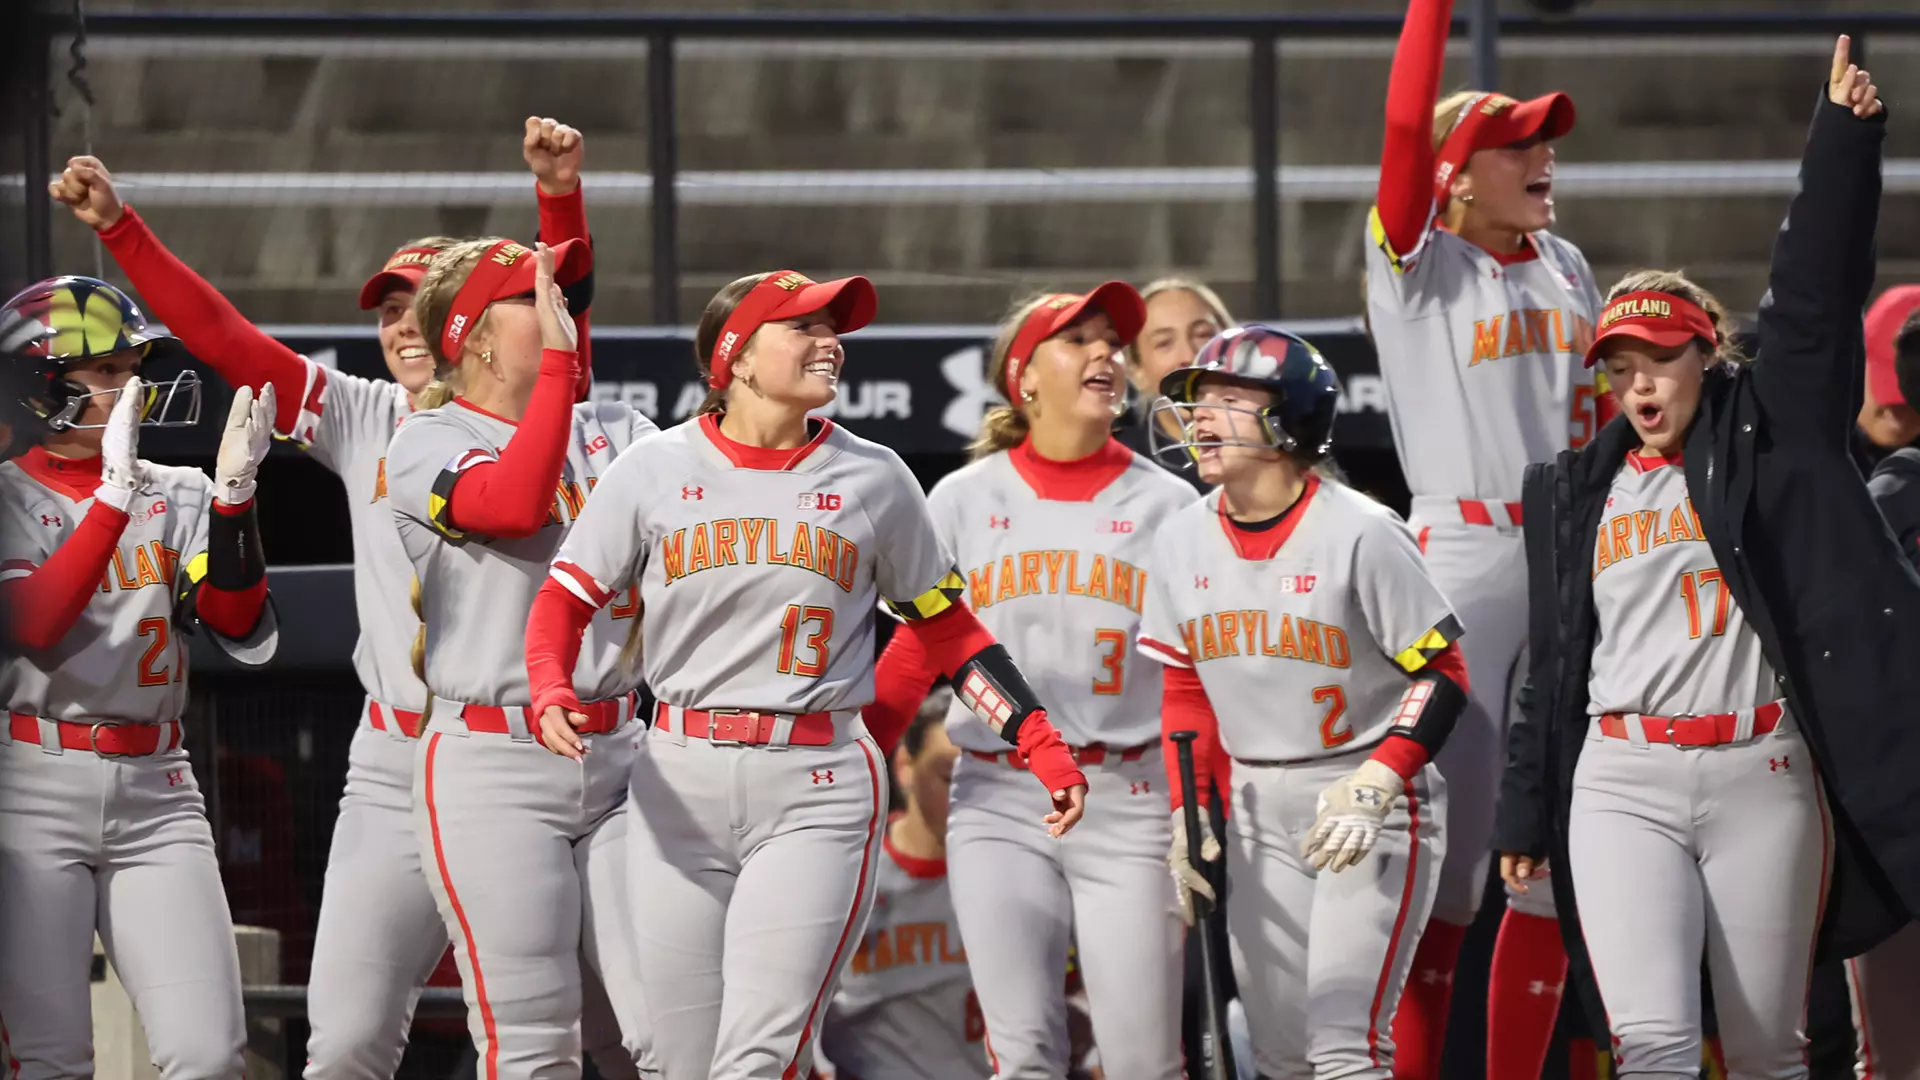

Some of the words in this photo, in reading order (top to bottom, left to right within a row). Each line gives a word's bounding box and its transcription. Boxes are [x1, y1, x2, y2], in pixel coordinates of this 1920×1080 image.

[1601, 298, 1670, 329] MARYLAND
[662, 518, 859, 592] MARYLAND
[1591, 496, 1707, 581] ARYLA
[1680, 567, 1731, 639] 17
[777, 604, 834, 678] 13
[1093, 628, 1127, 695] 3
[1177, 609, 1352, 669] MARYLAND
[1312, 684, 1354, 749] 2
